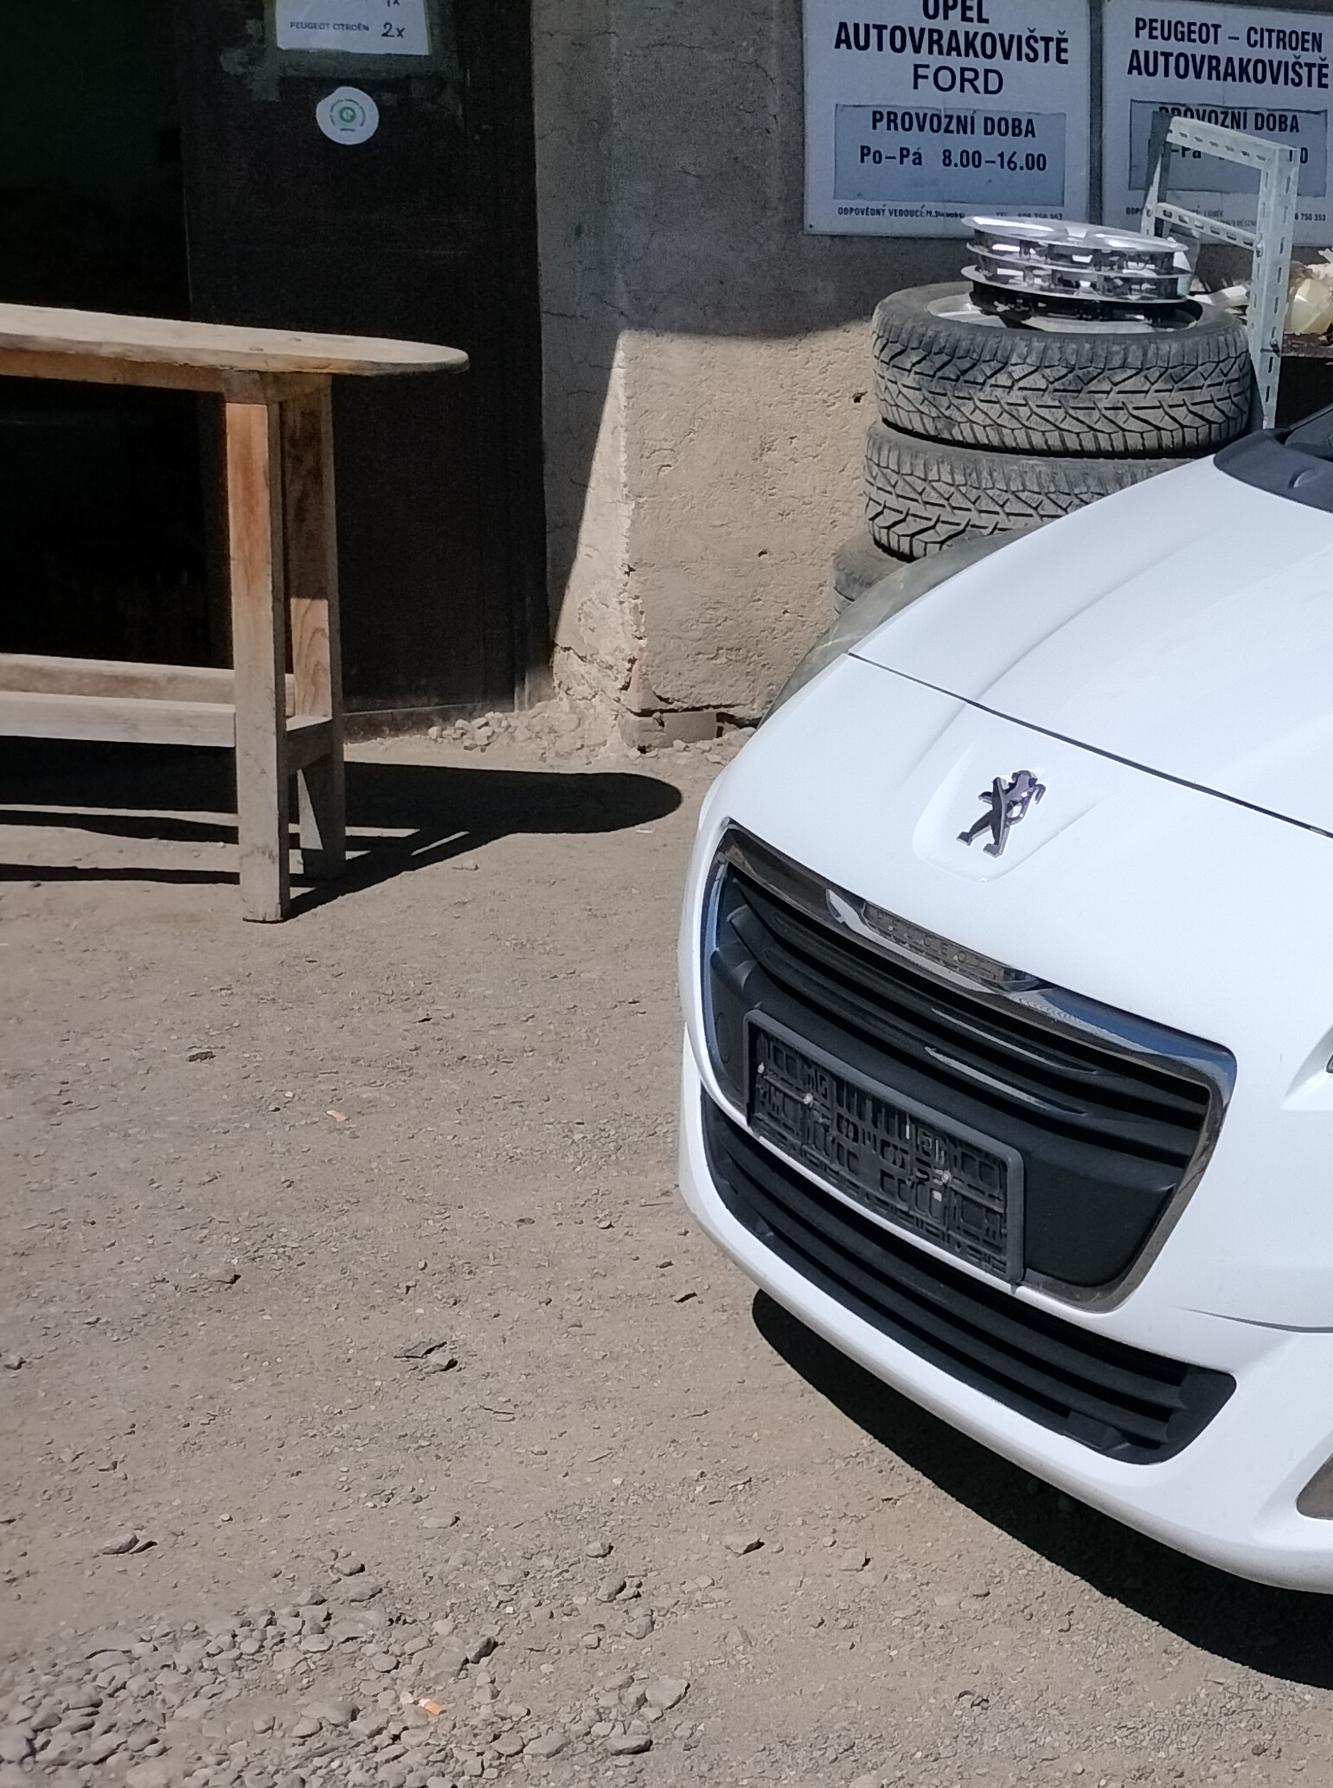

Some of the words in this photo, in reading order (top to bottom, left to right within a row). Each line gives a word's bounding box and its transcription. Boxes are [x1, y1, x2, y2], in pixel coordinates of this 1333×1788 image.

[290, 21, 330, 31] PEUGEOT
[922, 0, 990, 24] OPEL
[834, 21, 1069, 65] AUTOVRAKOVIŠTĚ
[1135, 17, 1222, 45] PEUGEOT
[1246, 26, 1322, 53] CITROEN
[912, 63, 1004, 95] FORD
[1127, 49, 1329, 89] AUTOVRAKOVIŠTĚ
[871, 110, 977, 135] PROVOZNÍ
[983, 116, 1036, 138] DOBA
[1254, 112, 1300, 133] DOBA
